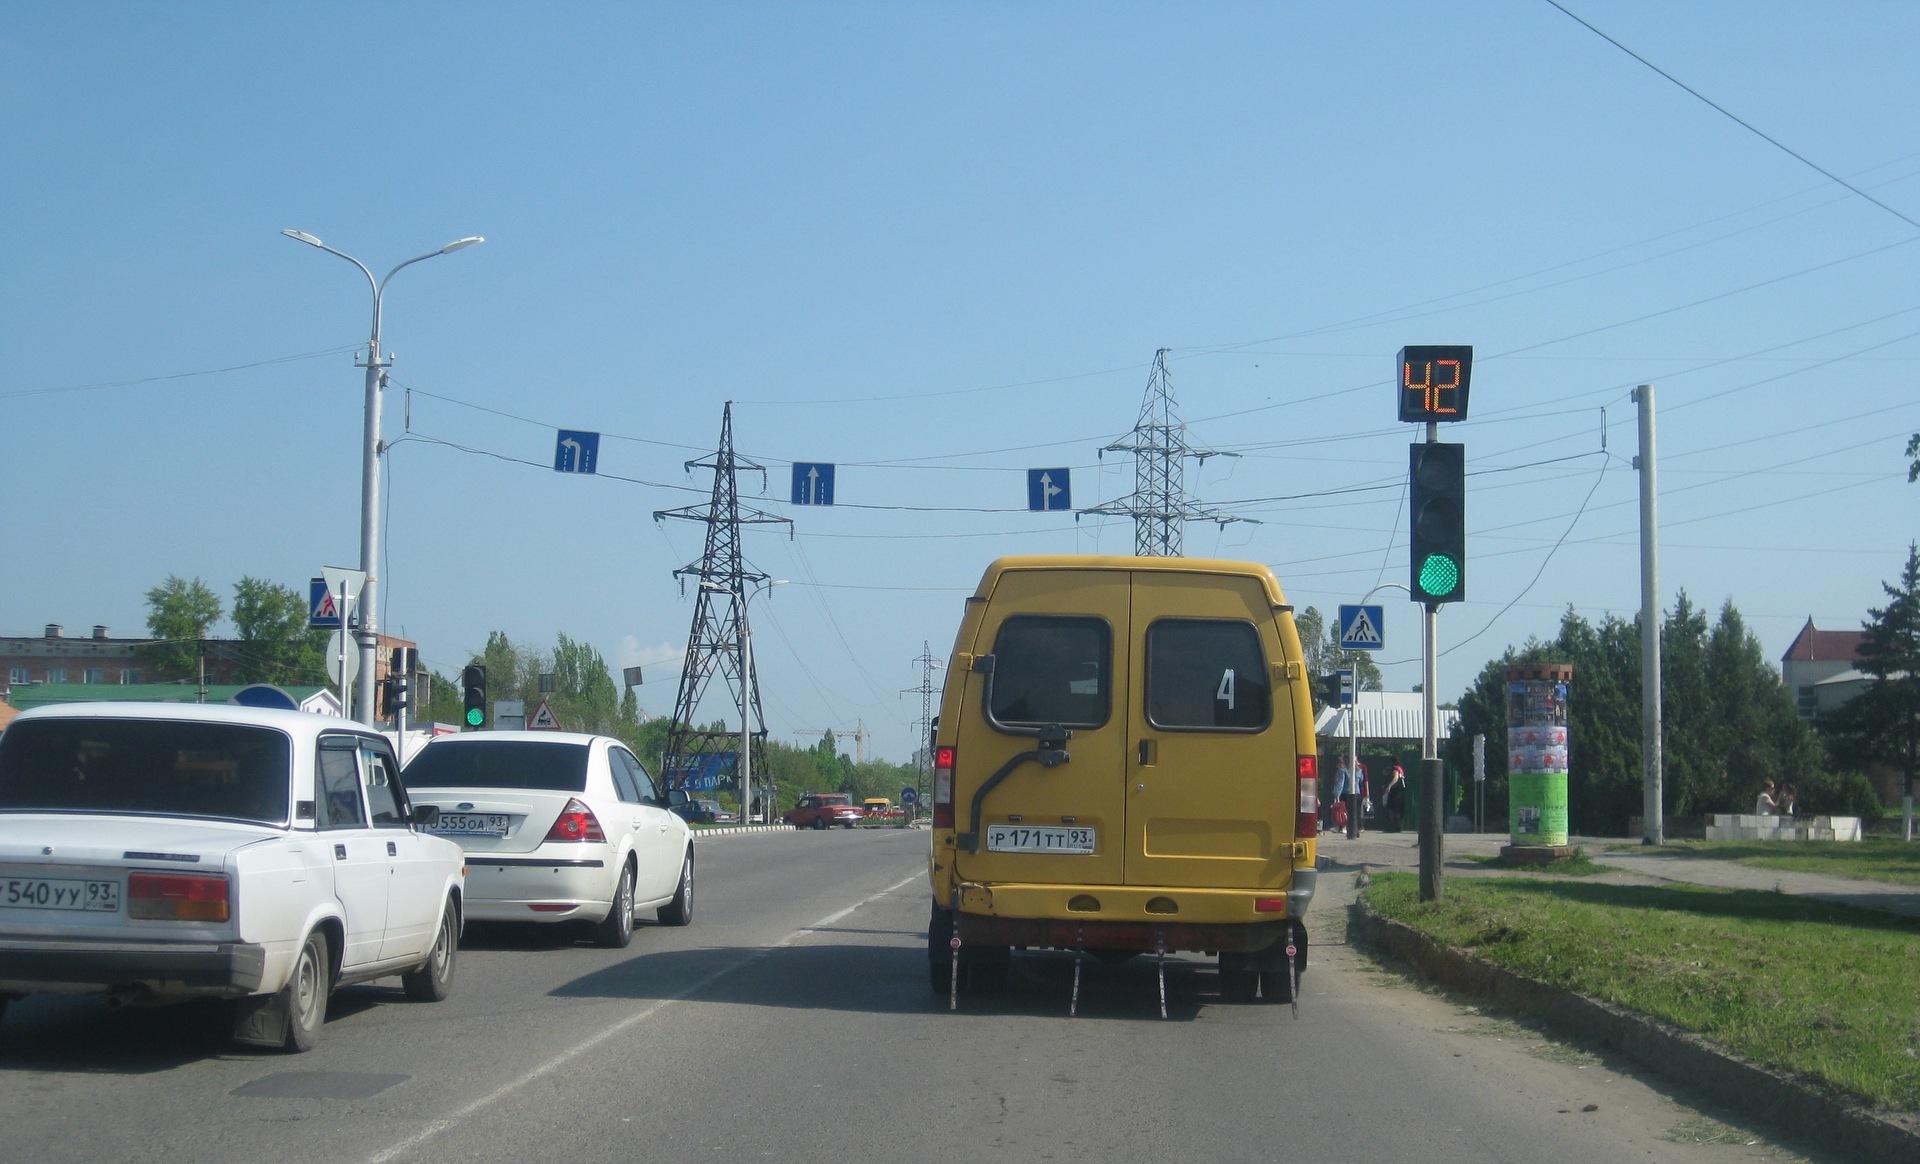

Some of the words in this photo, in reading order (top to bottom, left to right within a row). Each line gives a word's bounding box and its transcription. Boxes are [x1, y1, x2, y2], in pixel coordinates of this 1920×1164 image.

[1404, 360, 1460, 413] 42
[1216, 668, 1235, 710] 4
[704, 772, 734, 787] ПАРК
[489, 816, 503, 827] 93
[1070, 831, 1088, 844] 93
[0, 881, 81, 906] 540УУ
[88, 883, 111, 901] 93
